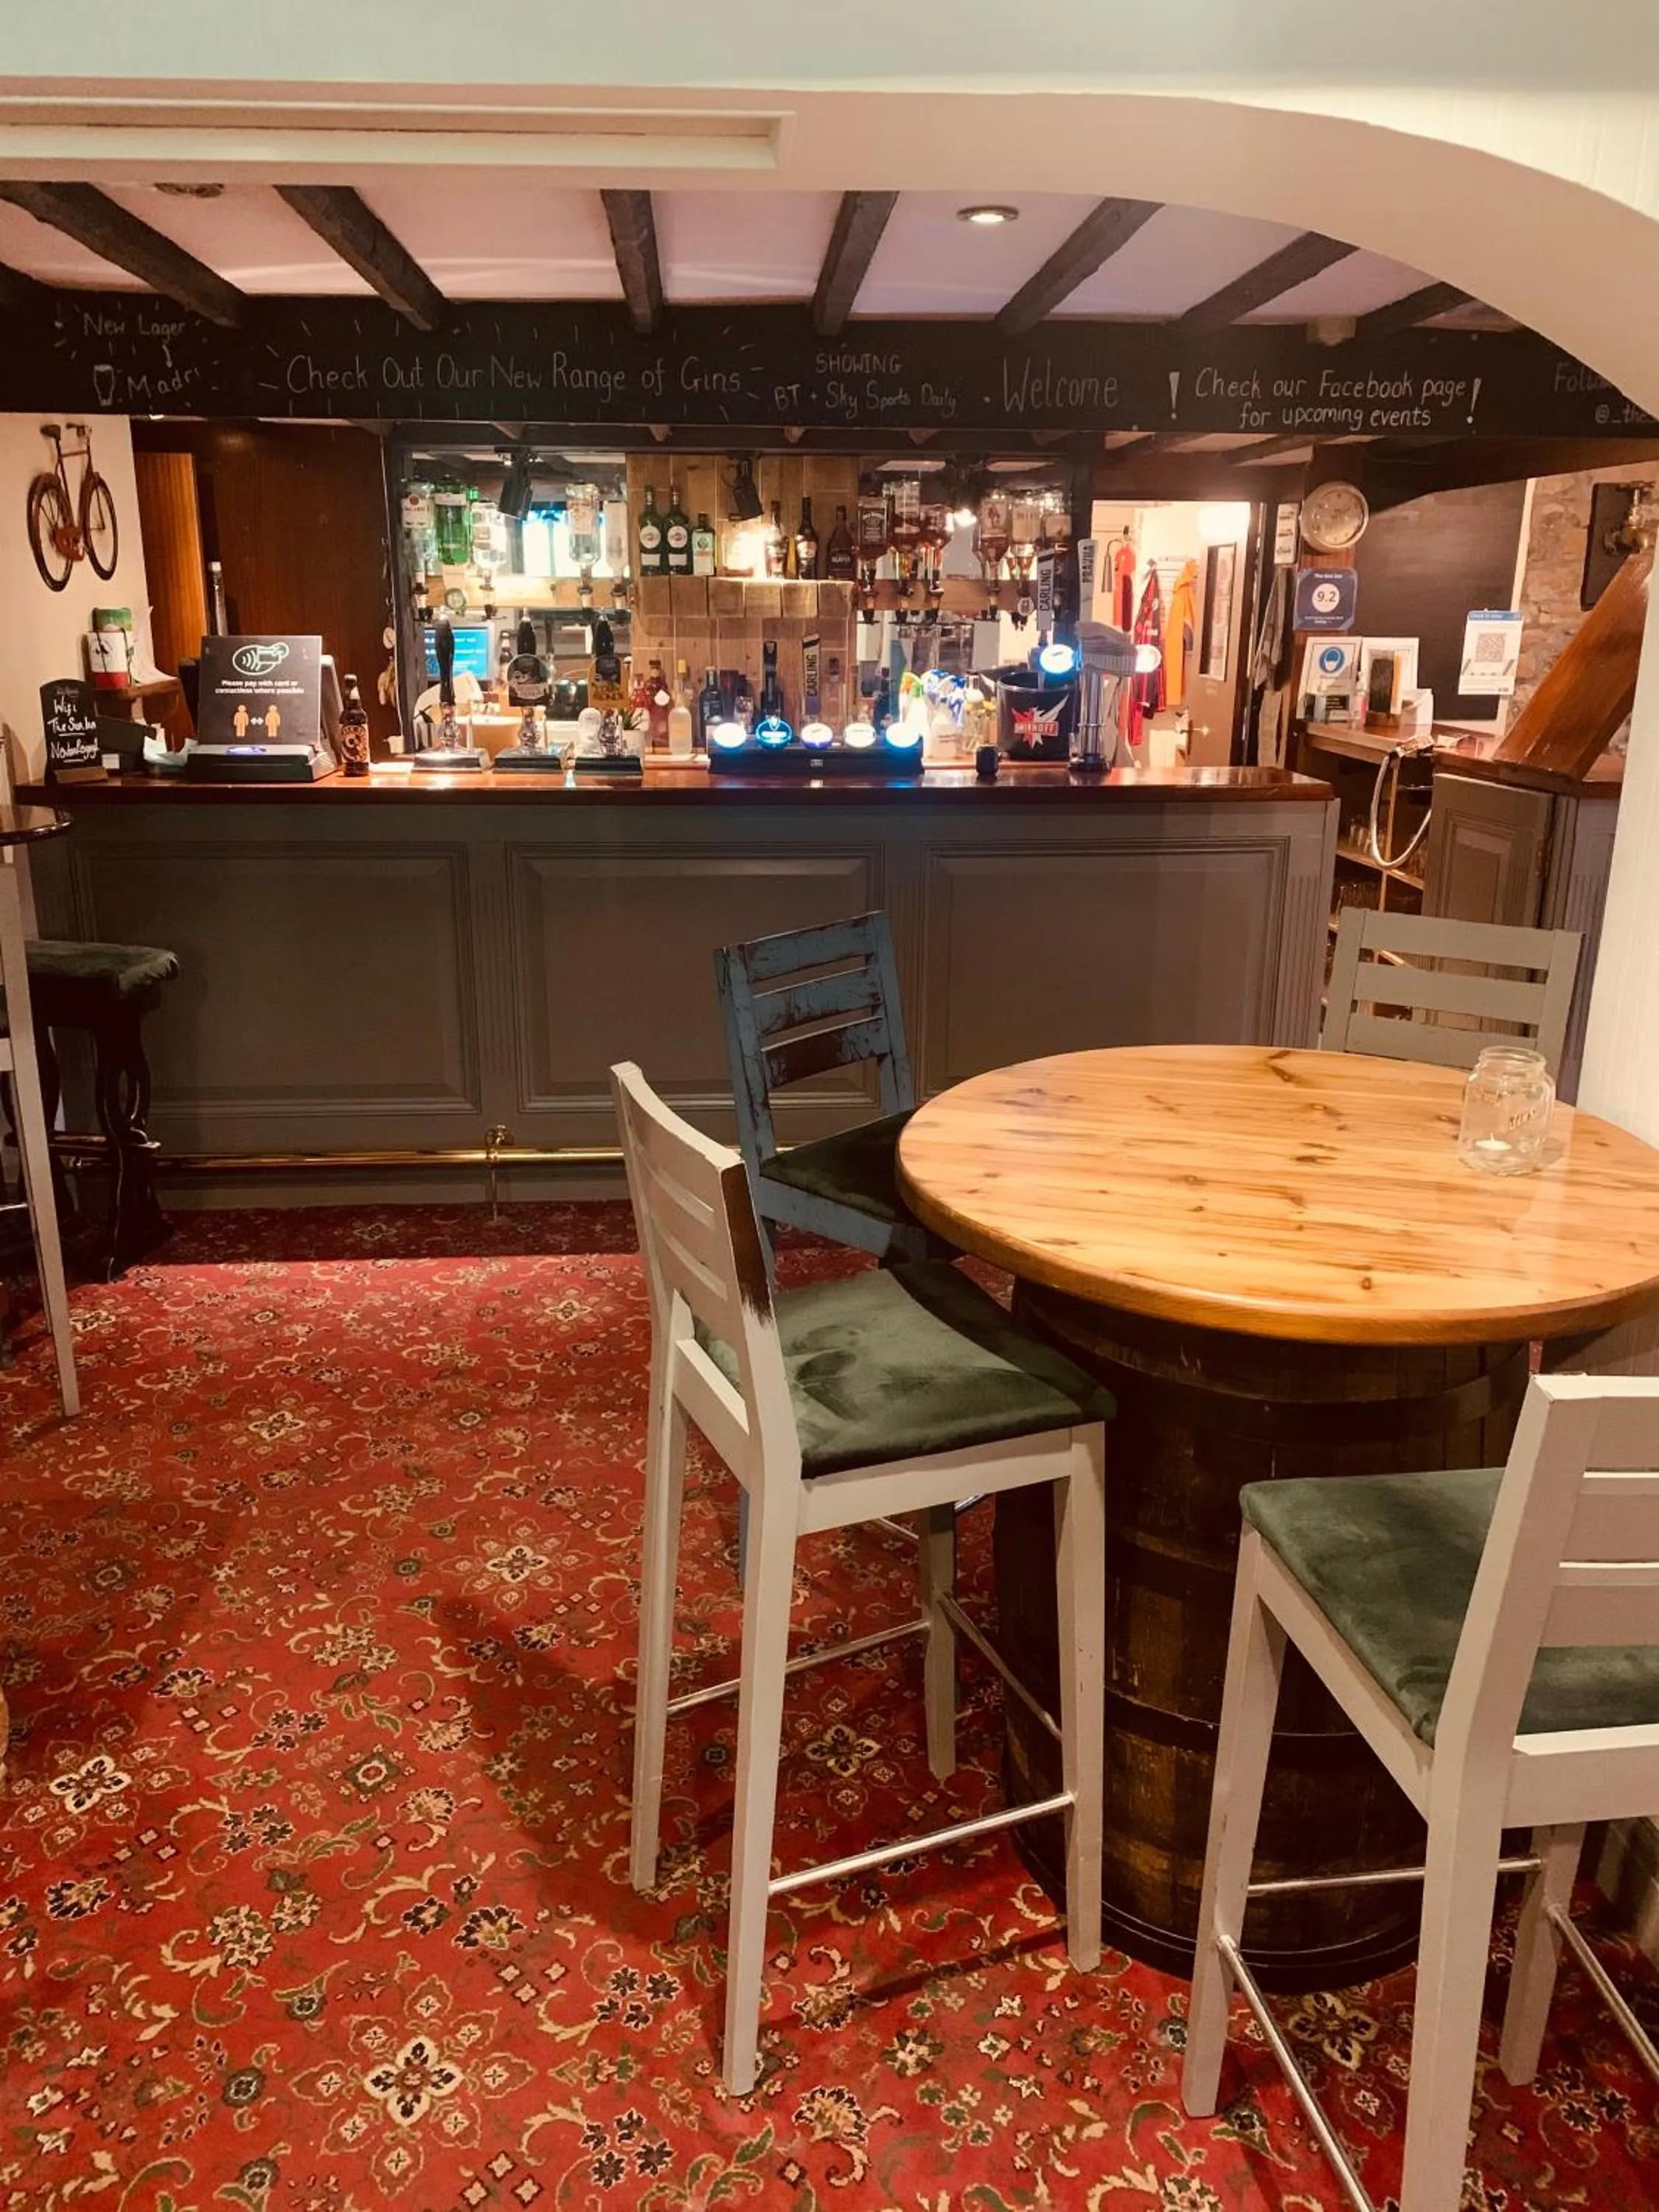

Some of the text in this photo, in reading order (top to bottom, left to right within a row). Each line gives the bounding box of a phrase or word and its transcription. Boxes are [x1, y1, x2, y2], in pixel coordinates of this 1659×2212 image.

[83, 312, 187, 344] New Lager
[287, 350, 742, 403] Check Out Our New Range of Gins
[815, 352, 903, 375] SHOWING
[128, 367, 201, 400] Madri
[773, 379, 957, 420] BT Sky Sports Daily
[1003, 355, 1119, 413] Welcome
[1194, 366, 1263, 400] Check
[1273, 379, 1308, 398] our
[1318, 369, 1414, 399] Facebook
[1238, 400, 1432, 432] for upcoming events
[1039, 568, 1052, 611] CARLING
[1317, 591, 1337, 602] 9.2
[244, 680, 257, 688] pay
[806, 654, 818, 697] CARLING
